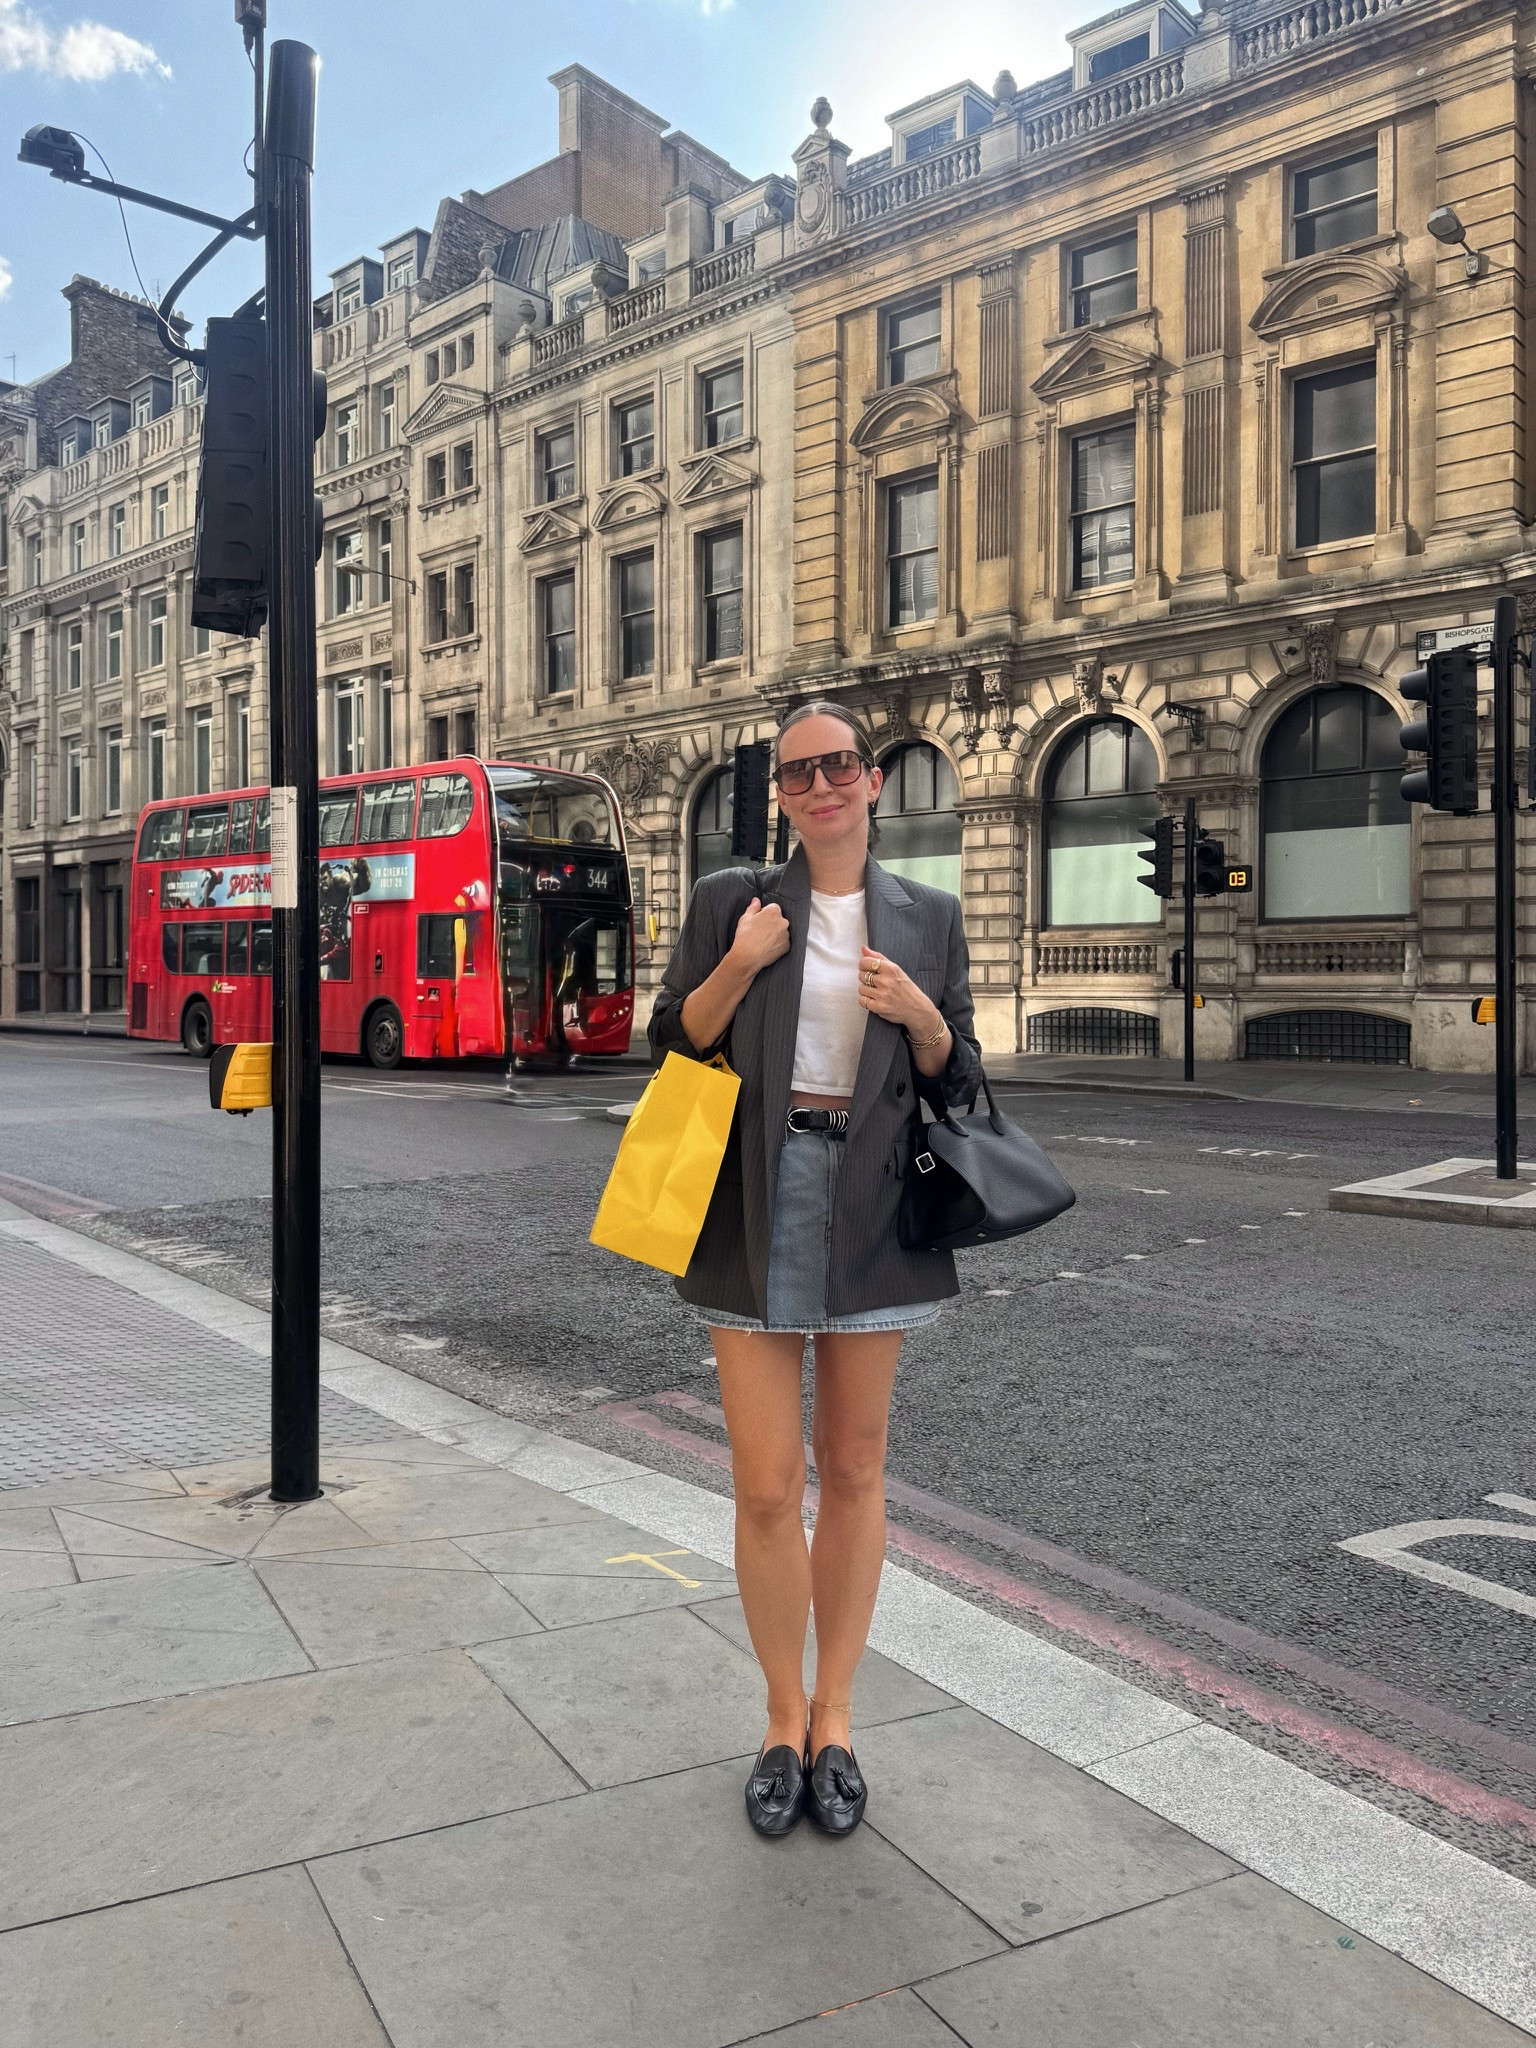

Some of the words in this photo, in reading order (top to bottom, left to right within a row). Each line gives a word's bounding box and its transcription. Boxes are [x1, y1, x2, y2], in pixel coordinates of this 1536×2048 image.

[1445, 626, 1494, 638] BISHOPSGATE
[383, 866, 408, 877] CINEMAS
[587, 869, 608, 889] 344
[1229, 871, 1246, 886] 03
[1052, 1134, 1152, 1146] LOOK
[1196, 1146, 1319, 1160] LEFT
